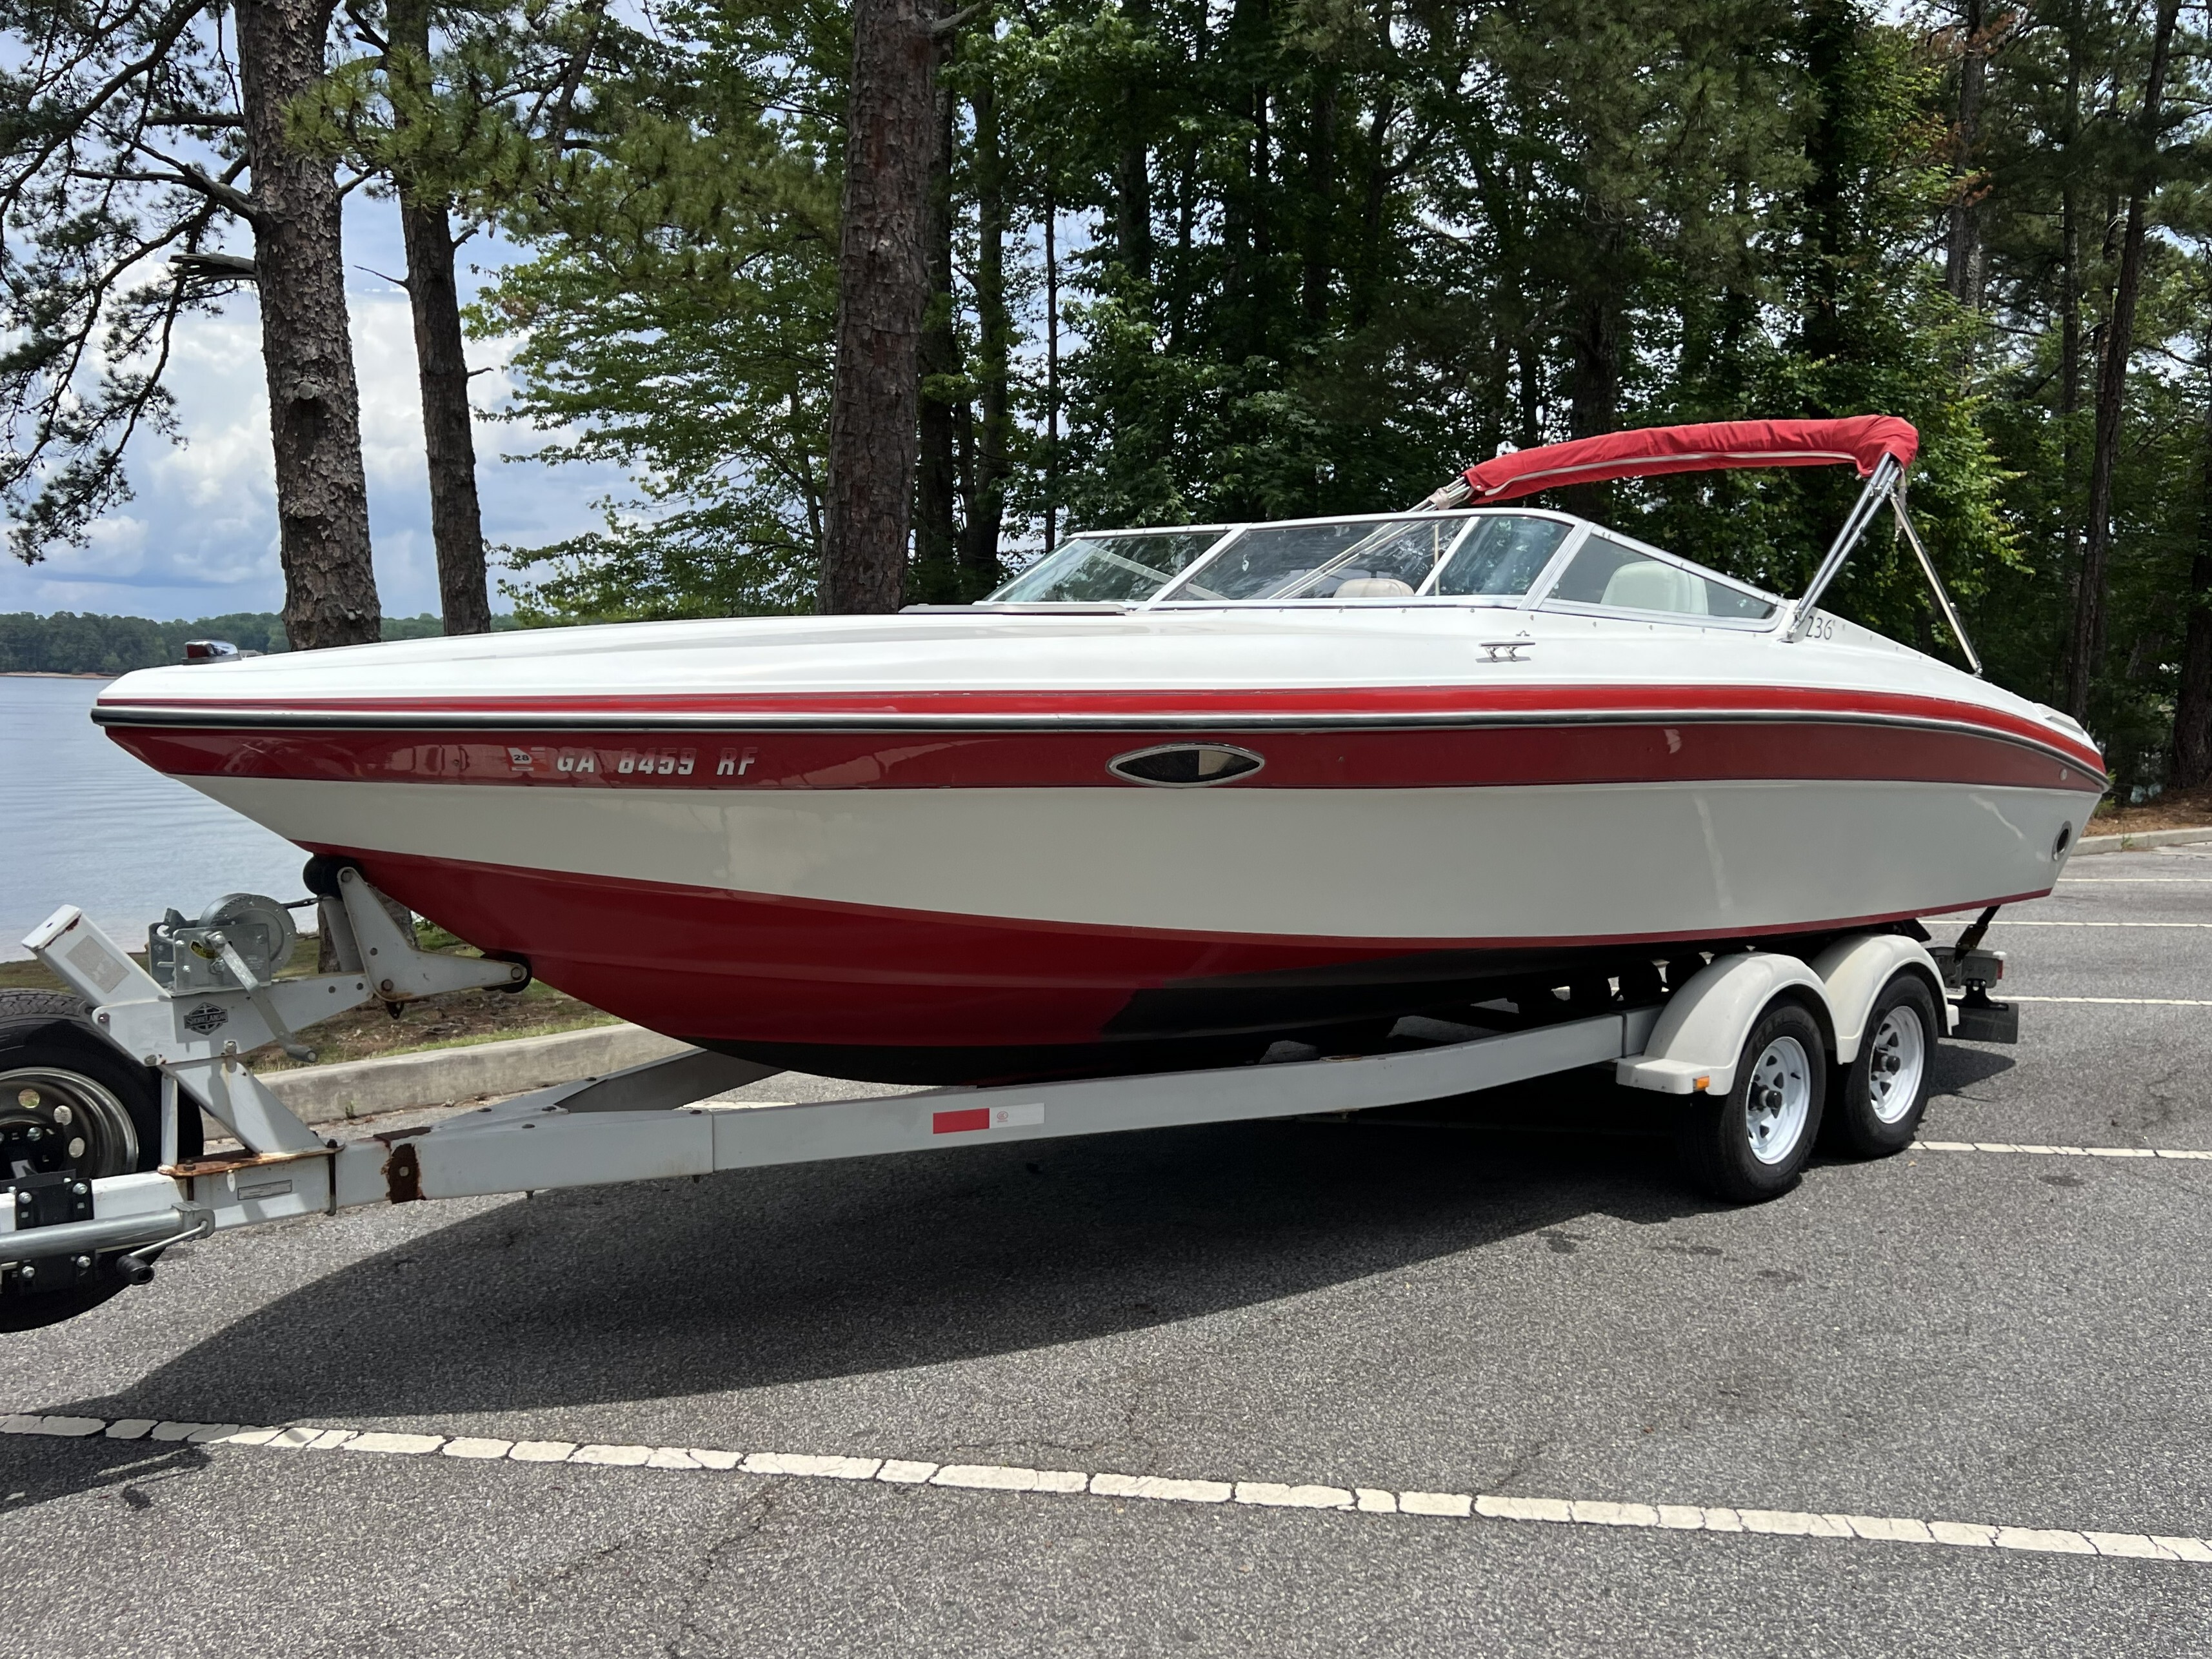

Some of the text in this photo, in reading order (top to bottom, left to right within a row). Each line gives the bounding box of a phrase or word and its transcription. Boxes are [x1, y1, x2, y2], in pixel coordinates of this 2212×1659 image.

[1805, 615, 1833, 641] 236
[557, 747, 758, 775] GA 8459 RF
